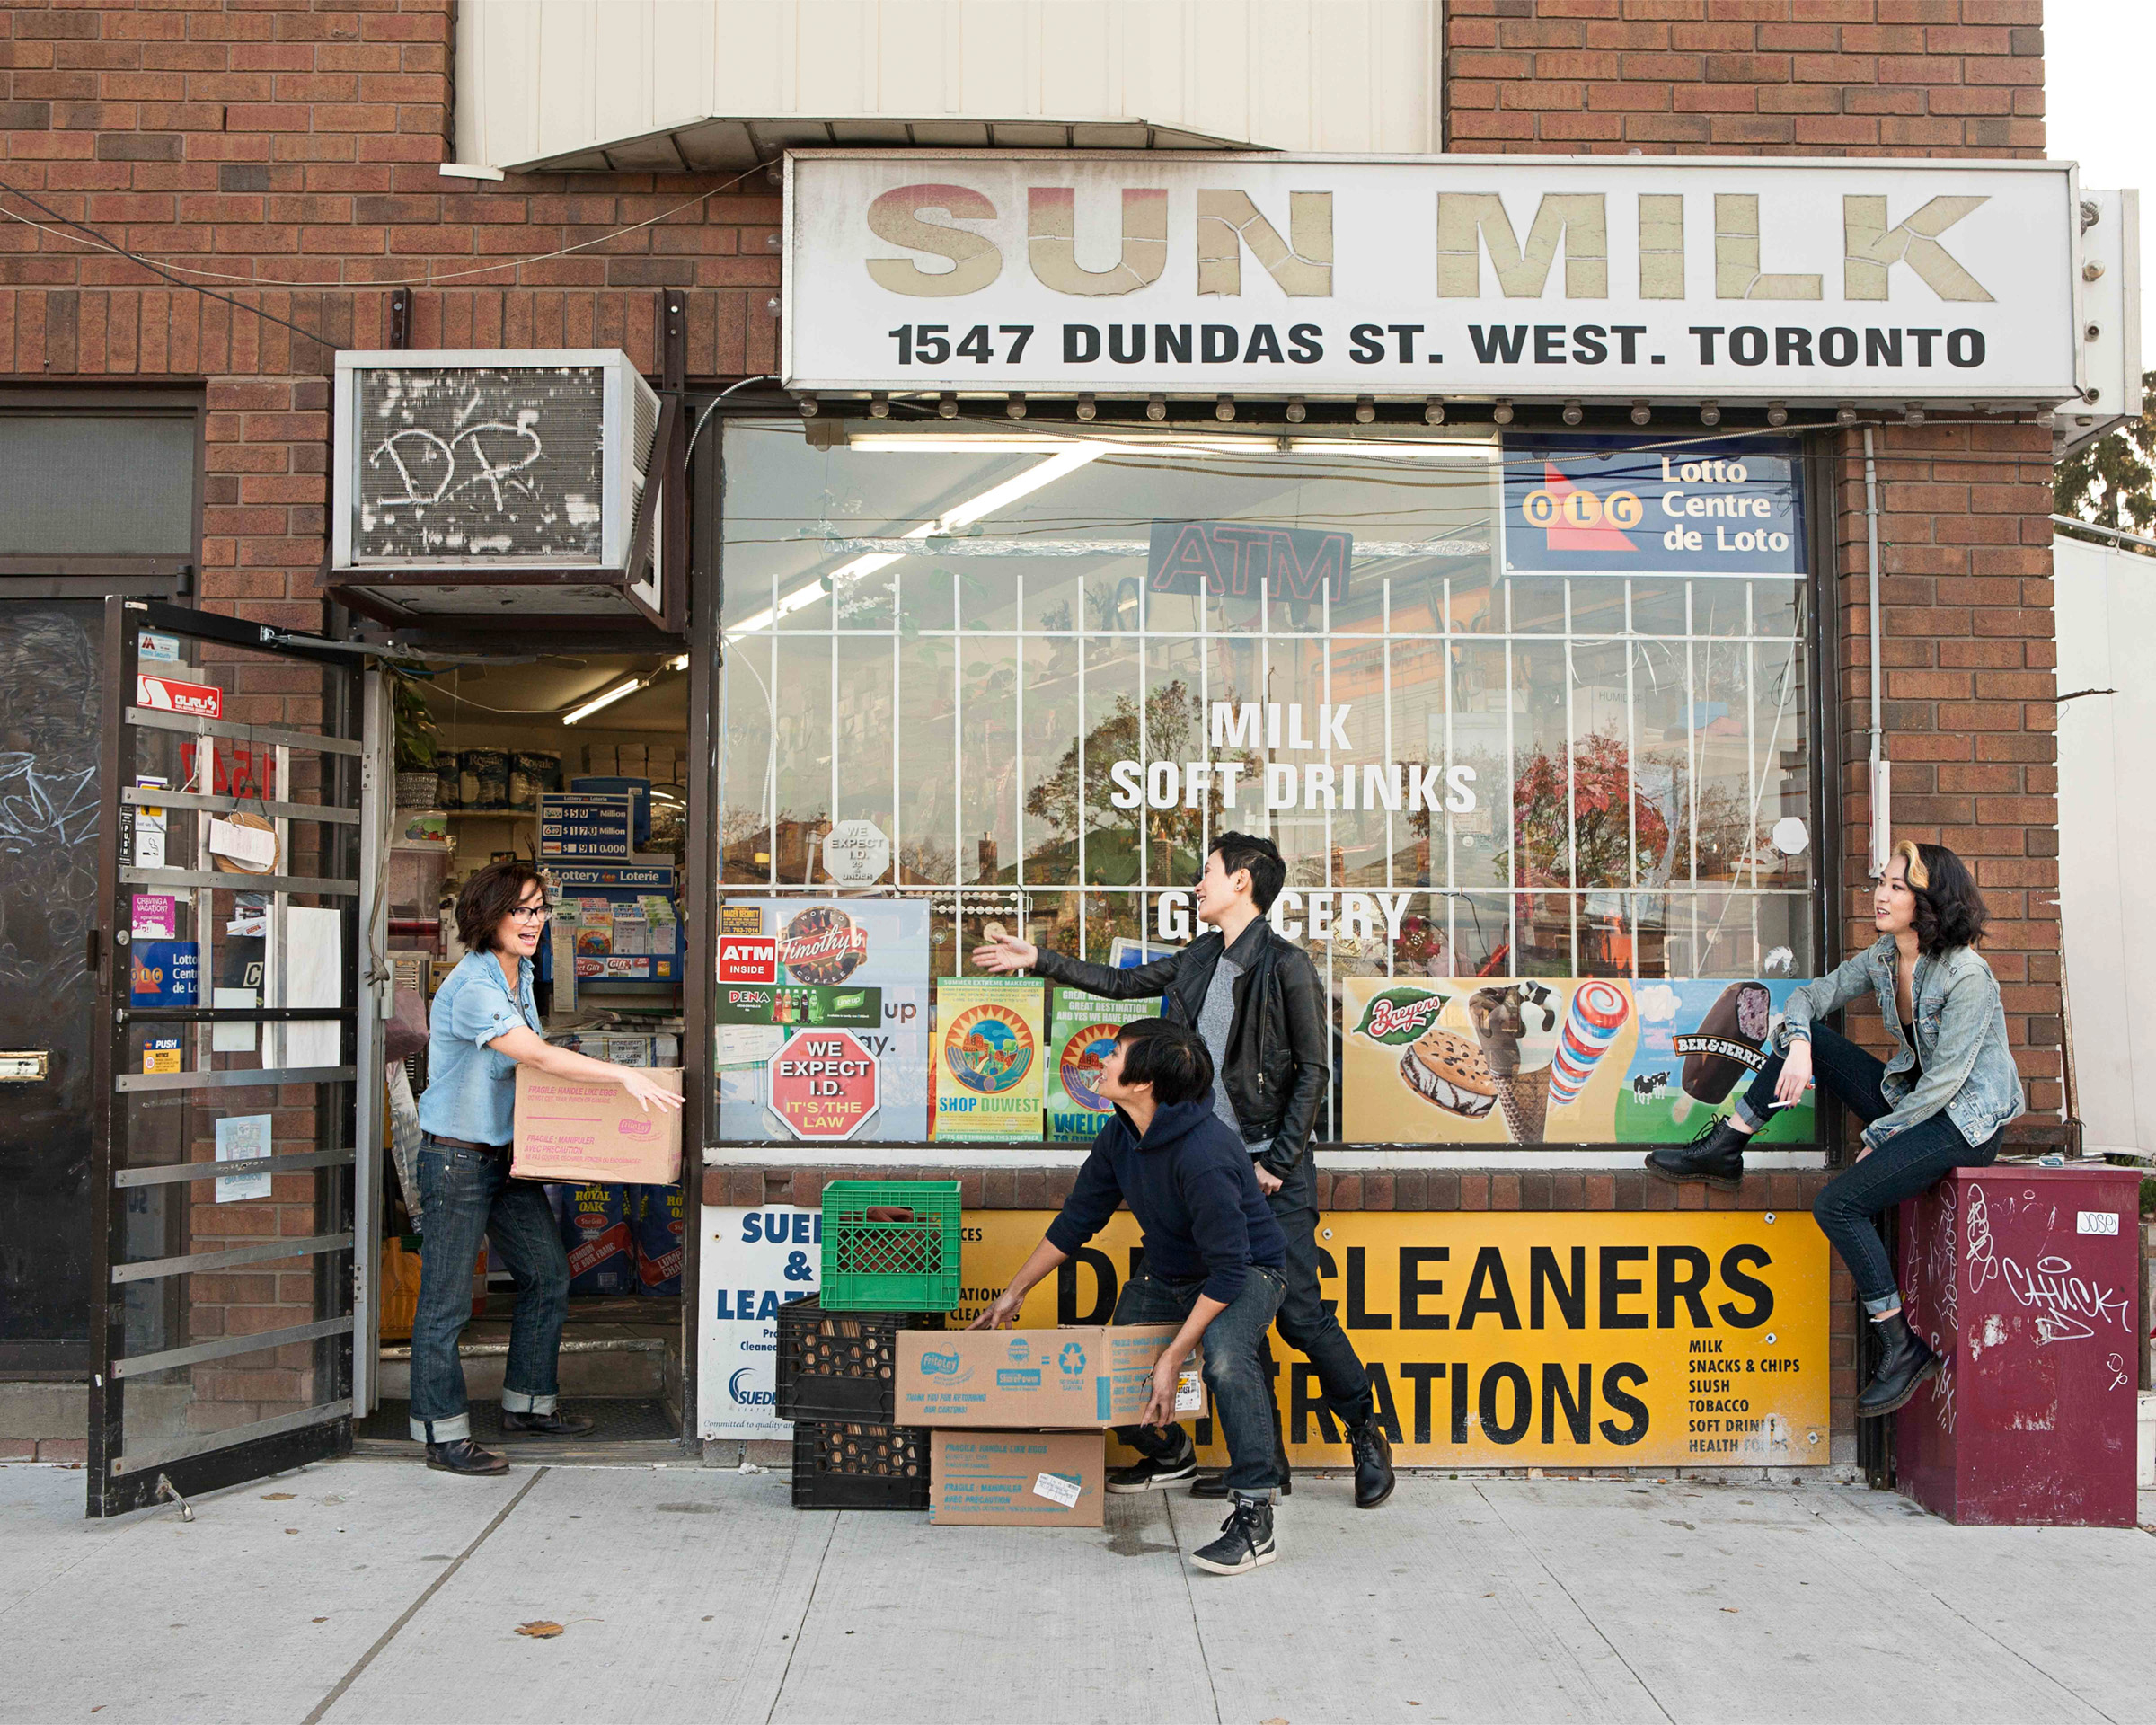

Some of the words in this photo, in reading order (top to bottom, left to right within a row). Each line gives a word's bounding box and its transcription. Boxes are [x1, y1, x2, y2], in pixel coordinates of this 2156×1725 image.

[865, 182, 1334, 298] SUN
[1436, 191, 1997, 302] MILK
[888, 323, 1035, 366] 1547
[1062, 323, 1325, 365] DUNDAS
[1348, 323, 1444, 365] ST.
[1467, 324, 1666, 365] WEST.
[1689, 326, 1987, 369] TORONTO
[1662, 457, 1748, 483] Lotto
[1527, 492, 1637, 526] OLG
[1661, 491, 1772, 518] Centre
[1663, 524, 1703, 551] de
[1716, 526, 1790, 552] Loto
[1153, 526, 1346, 602] ATM
[1211, 702, 1352, 749] MILK
[1110, 760, 1244, 809] SOFT
[1268, 764, 1477, 813] DRINKS
[599, 809, 626, 818] Million
[847, 827, 869, 837] WE
[832, 839, 884, 848] EXPECT
[554, 870, 599, 883] Lottery
[620, 871, 659, 882] Loterie
[137, 898, 162, 906] CRAVING
[800, 909, 844, 922] WORLD
[1158, 891, 1412, 940] GCERY
[721, 945, 774, 961] ATM
[609, 960, 626, 969] Gift
[730, 965, 764, 974] INSIDE
[246, 964, 261, 986] C
[796, 970, 846, 985] COFFEE
[172, 981, 185, 994] de
[729, 990, 771, 1004] DENA
[1063, 990, 1086, 1000] GREAT
[884, 1003, 917, 1023] up
[1068, 1002, 1094, 1011] GREAT
[1096, 1003, 1148, 1013] DESTINATION
[1056, 1011, 1073, 1021] AND
[1074, 1012, 1088, 1021] YES
[1089, 1012, 1100, 1022] WE
[1102, 1013, 1118, 1022] HAVE
[1368, 996, 1441, 1038] Breyers
[155, 1039, 178, 1048] PUSH
[807, 1041, 842, 1057] WE
[856, 1033, 896, 1057] ay.
[779, 1061, 870, 1076] EXPECT
[528, 1085, 556, 1094] FRAGILE:
[557, 1086, 583, 1095] HANDLE
[584, 1087, 599, 1095] LIKE
[599, 1088, 618, 1097] EGGS
[809, 1081, 844, 1096] I.D.
[786, 1101, 819, 1114] IT'S
[826, 1101, 862, 1114] THE
[939, 1097, 977, 1112] SHOP
[980, 1098, 1040, 1113] DUWEST
[803, 1116, 844, 1128] LAW
[558, 1136, 595, 1145] MANIPULER
[525, 1145, 541, 1153] AVEC
[543, 1146, 584, 1154] PRECAUTION
[575, 1190, 611, 1202] ROYAL
[579, 1202, 605, 1212] OAK
[596, 1242, 616, 1258] FRANC
[657, 1250, 683, 1269] LUMP
[783, 1250, 814, 1281] &
[959, 1288, 1007, 1302] ATION
[717, 1289, 817, 1321] LEA
[1689, 1340, 1723, 1353] MILK
[1689, 1359, 1741, 1373] SNACKS
[1745, 1359, 1755, 1373] &
[1760, 1359, 1800, 1373] CHIPS
[1689, 1379, 1730, 1393] SLUSH
[1196, 1361, 1650, 1446] RATIONS
[1688, 1400, 1749, 1413] TOBACCO
[703, 1420, 745, 1429] Committed
[755, 1420, 782, 1432] quality
[1689, 1420, 1720, 1432] SOFT
[1726, 1420, 1777, 1432] DRINS
[979, 1445, 1008, 1454] HANDLE
[1010, 1446, 1026, 1454] LIKE
[1689, 1439, 1739, 1453] HEALTH
[980, 1484, 1022, 1493] MANIPULER
[944, 1495, 963, 1503] AVEC
[965, 1495, 1012, 1504] PRECAUTION
